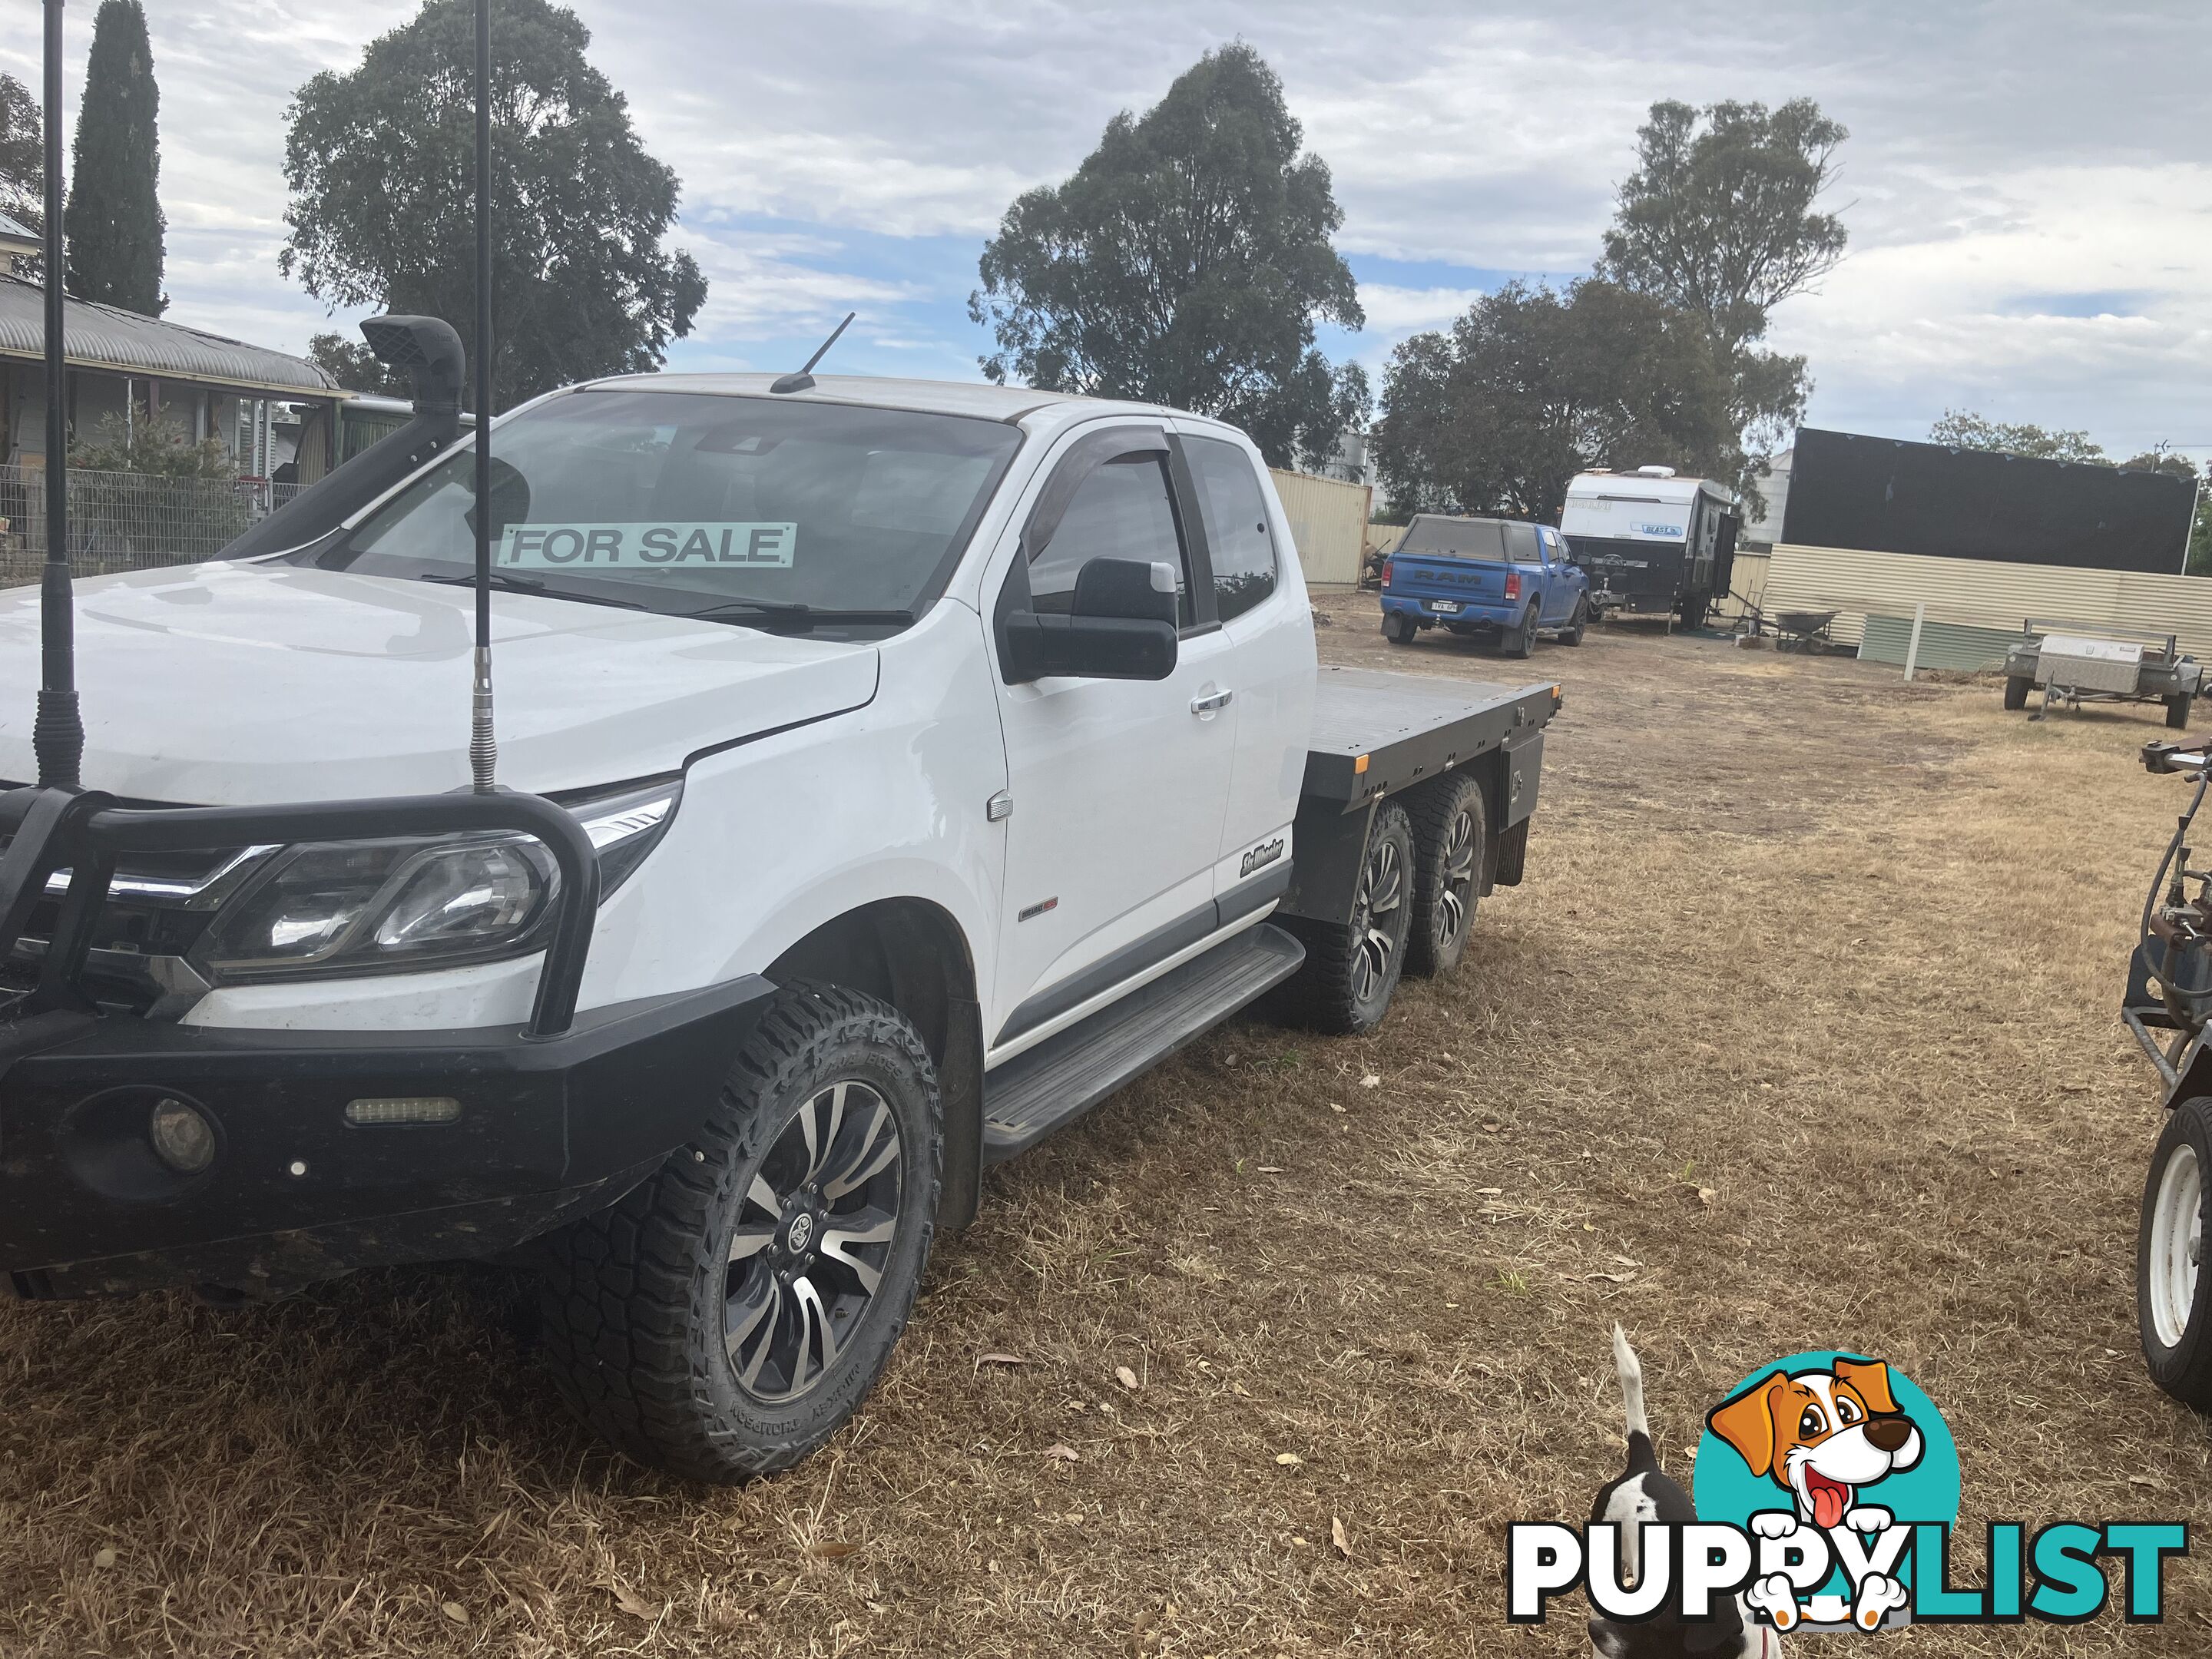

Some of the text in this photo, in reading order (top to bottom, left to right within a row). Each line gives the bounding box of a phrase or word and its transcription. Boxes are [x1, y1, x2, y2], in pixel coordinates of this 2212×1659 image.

[510, 528, 784, 564] FOR SALE
[1415, 570, 1482, 584] RAM
